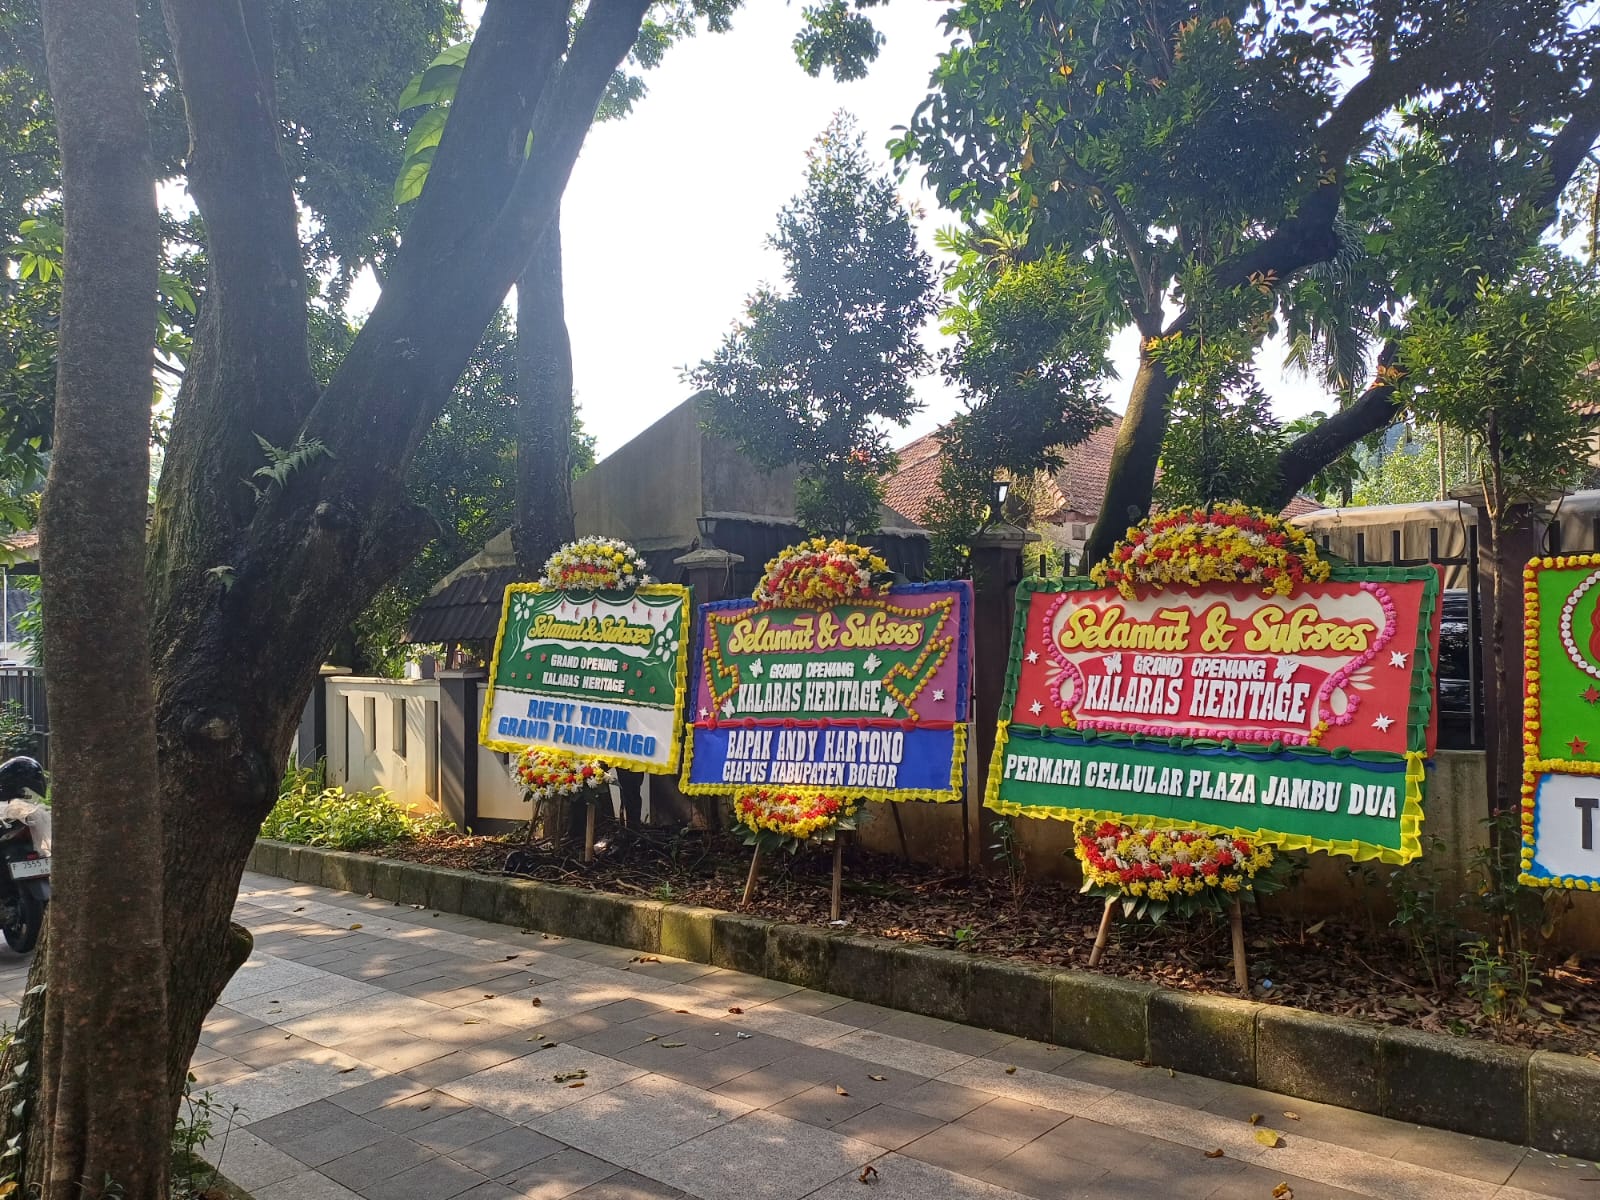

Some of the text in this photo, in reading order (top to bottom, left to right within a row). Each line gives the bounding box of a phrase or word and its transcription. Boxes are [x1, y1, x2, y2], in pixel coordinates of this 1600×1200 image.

[528, 614, 654, 645] Selamat & Sukses
[728, 611, 922, 653] Selamat & Sukses
[1060, 606, 1376, 652] Selamat & Sukses
[551, 654, 618, 672] GRAND OPENING
[769, 662, 855, 679] GRAND OPENING
[1133, 655, 1267, 680] GRAND OPENING
[542, 671, 625, 693] KALARAS HERITAGE
[737, 680, 882, 713] KALARAS HERITAGE
[527, 699, 630, 731] RIFKY TORIK
[1083, 674, 1311, 724] KALARAS HERITAGE
[498, 716, 657, 757] GRAND PANGRANGO
[726, 730, 904, 764] BAPAK ANDY HARTONO
[722, 761, 898, 787] CIAPUS KABUPATEN BOGOR
[1003, 754, 1396, 818] PERMATA CELLULAR PLAZA JAMBU DUA
